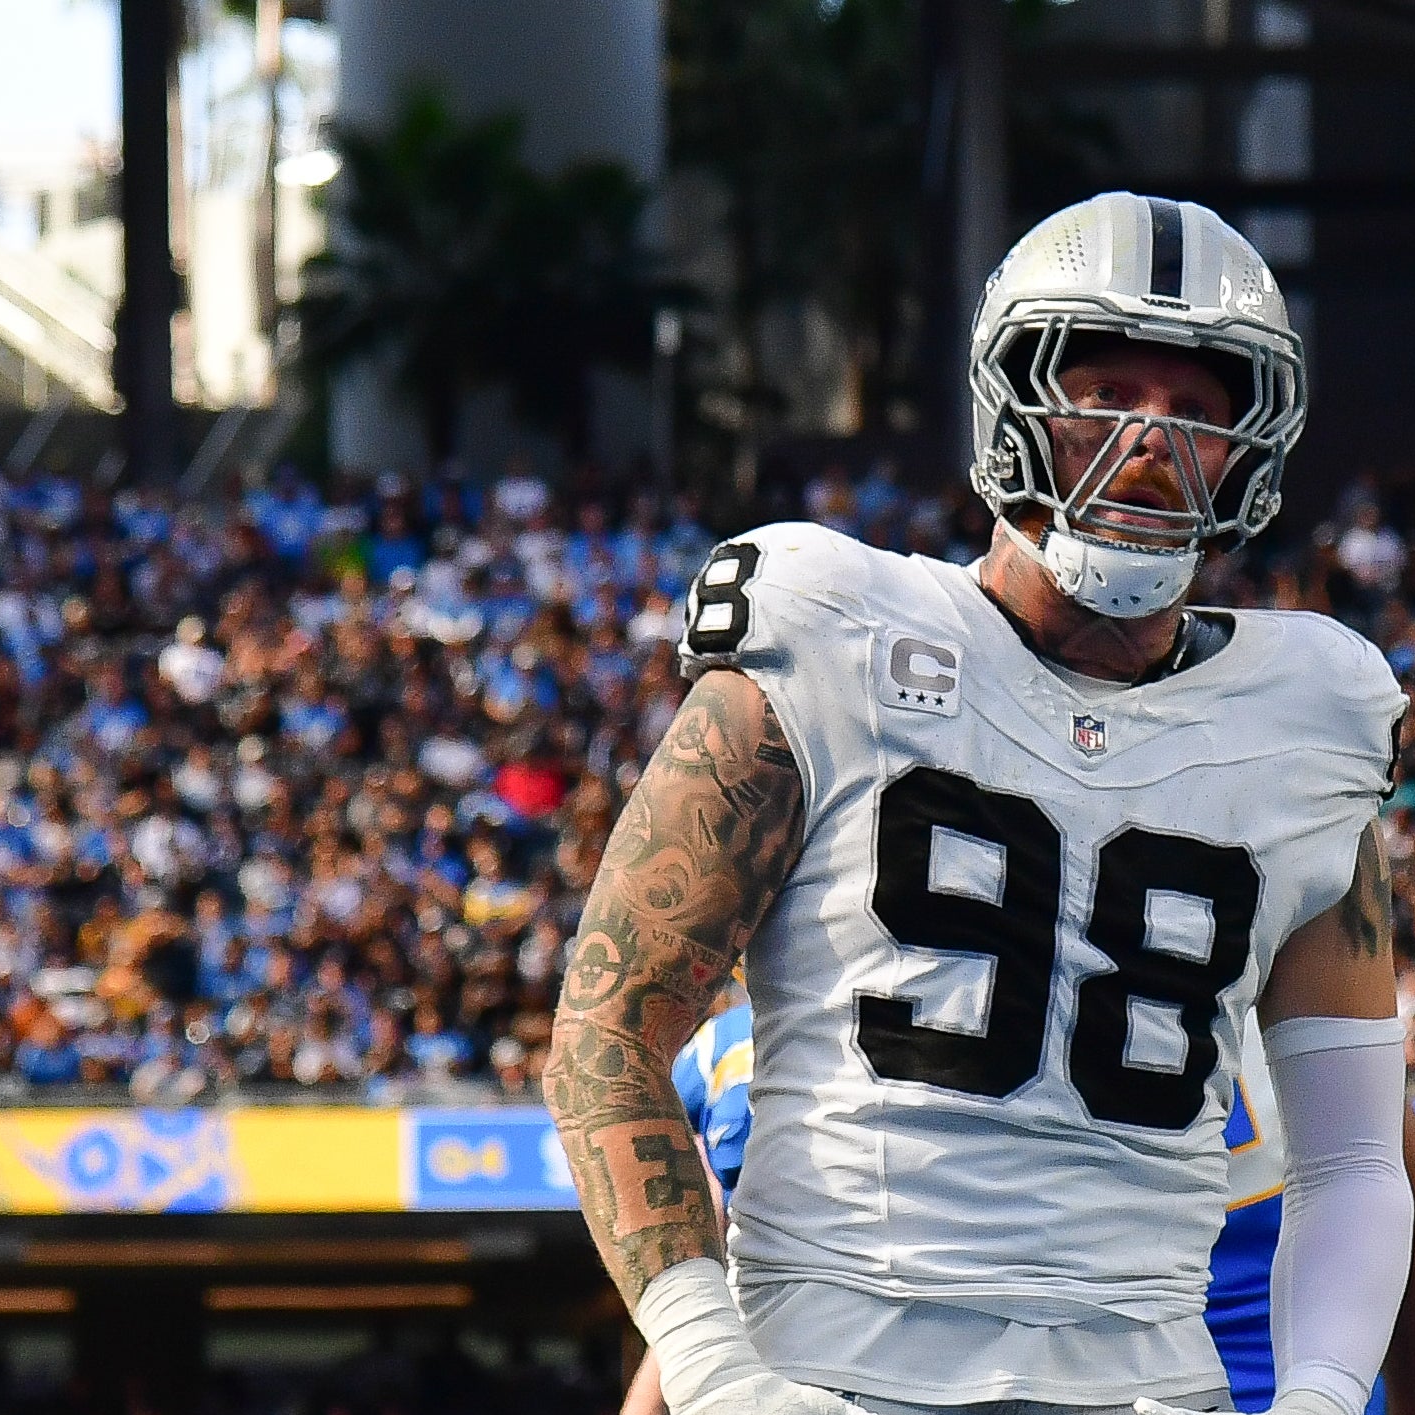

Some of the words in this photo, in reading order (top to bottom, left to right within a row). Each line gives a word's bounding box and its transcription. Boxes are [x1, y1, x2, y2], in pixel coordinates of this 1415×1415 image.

[890, 637, 956, 693] C
[1077, 729, 1103, 749] NFL
[854, 764, 1264, 1132] 98
